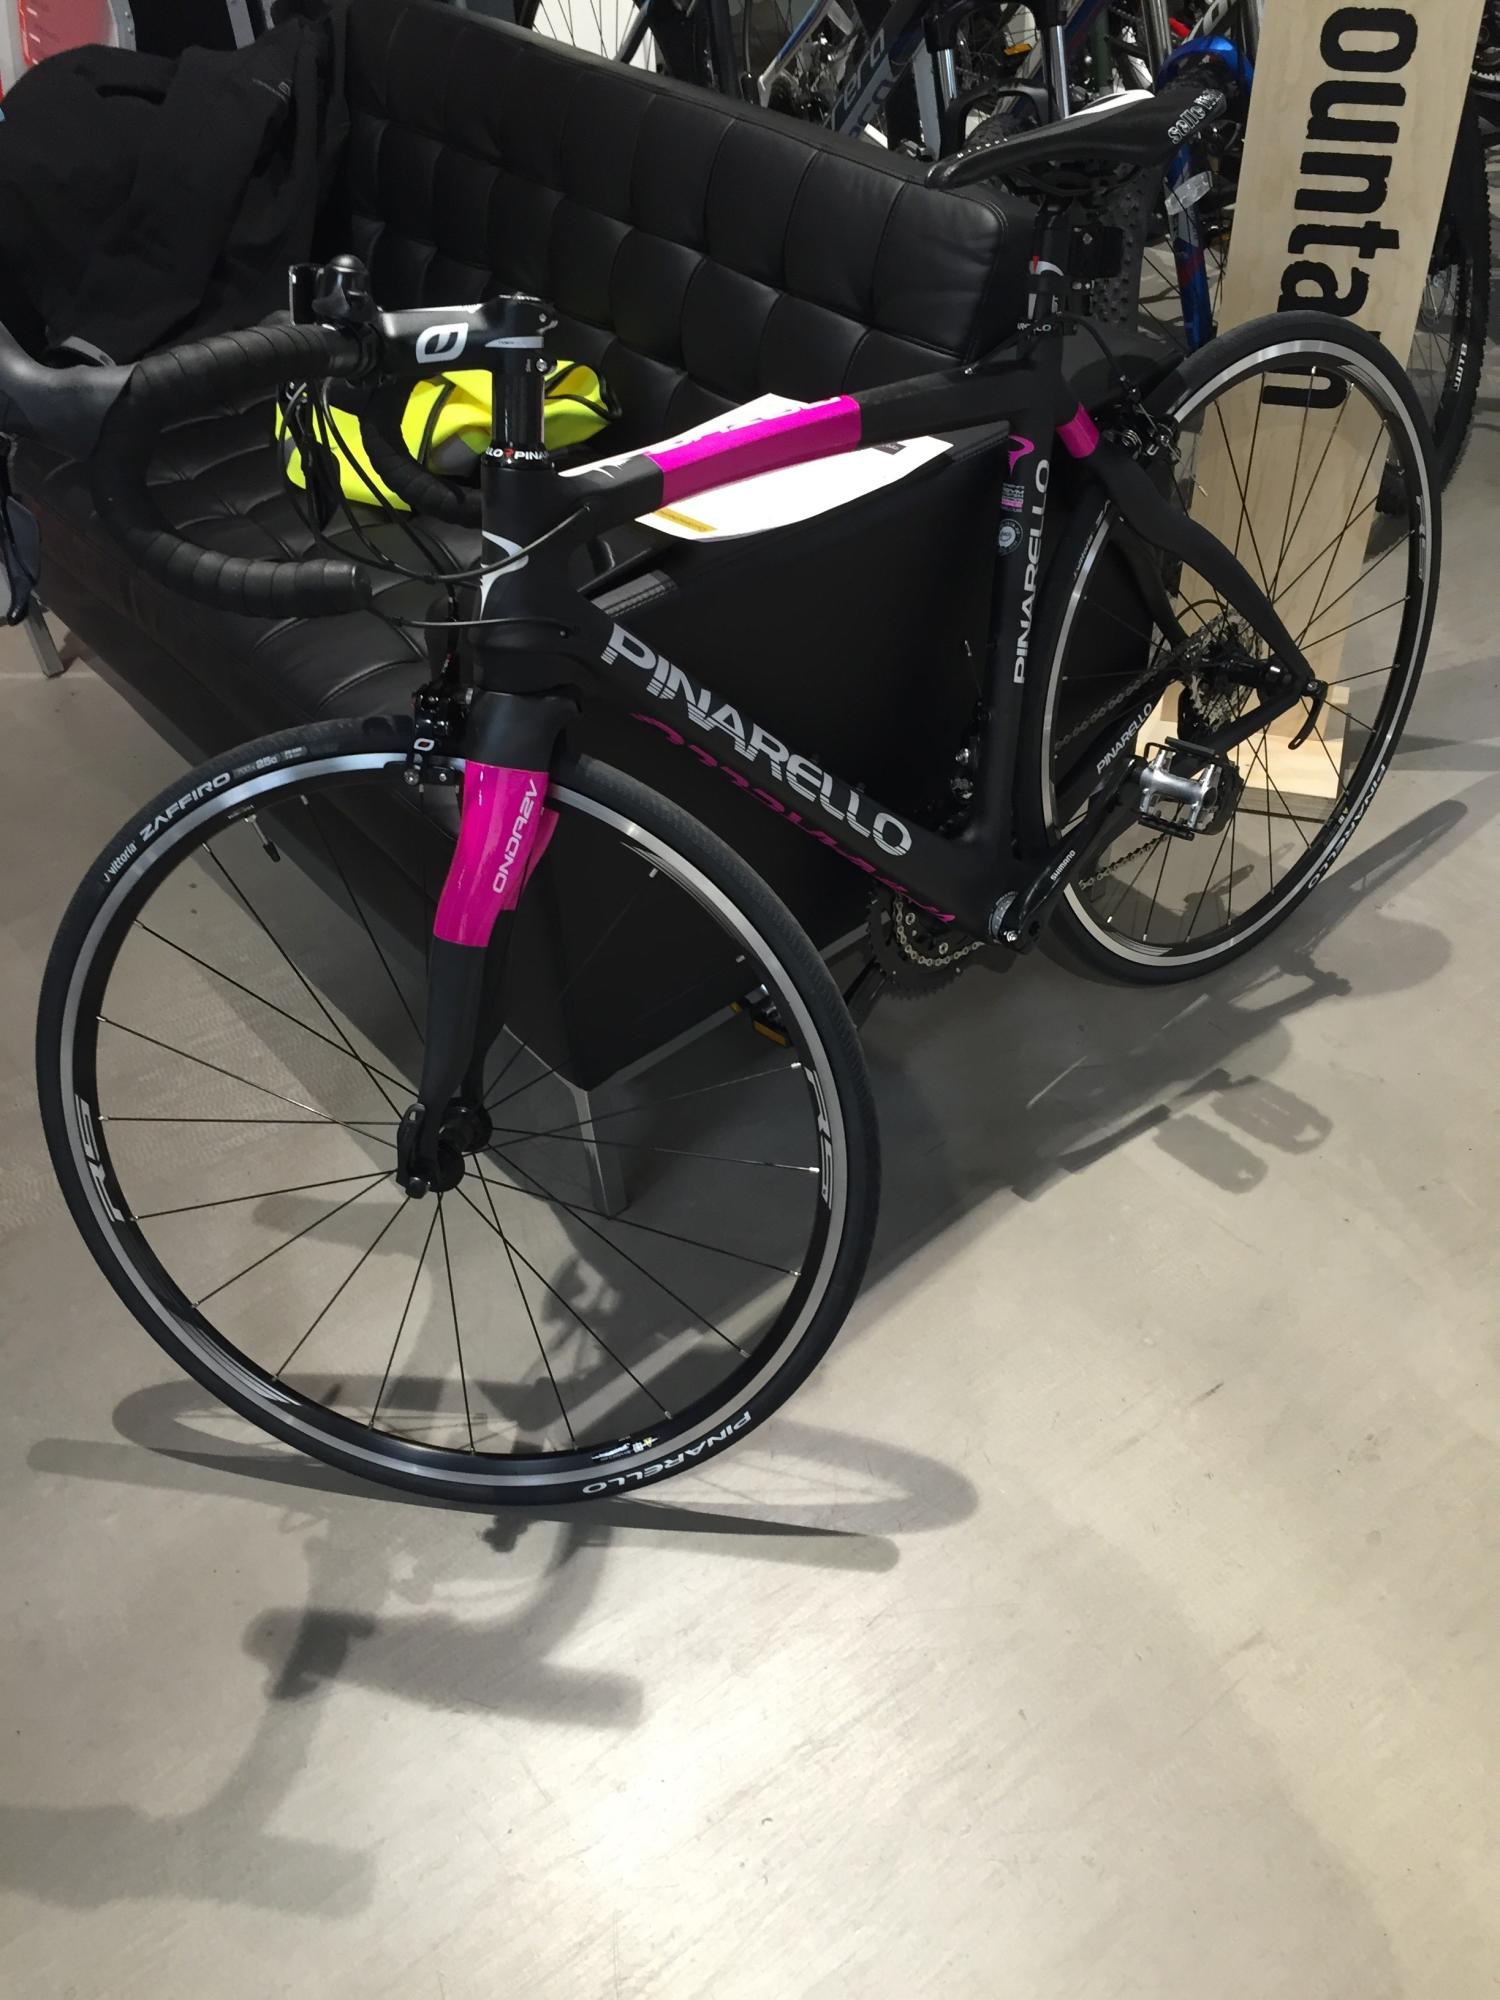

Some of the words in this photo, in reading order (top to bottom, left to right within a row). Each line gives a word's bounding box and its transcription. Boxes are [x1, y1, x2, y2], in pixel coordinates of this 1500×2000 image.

[1262, 7, 1418, 409] ountan
[1013, 459, 1050, 684] PINARELLO
[600, 622, 912, 857] PINARELLO
[1096, 702, 1153, 775] PINARELLO
[139, 771, 231, 842] ZAFFIRO
[492, 778, 539, 893] ONDA2V
[1049, 849, 1076, 882] SHIMANO
[582, 1410, 752, 1494] PINARELLO
